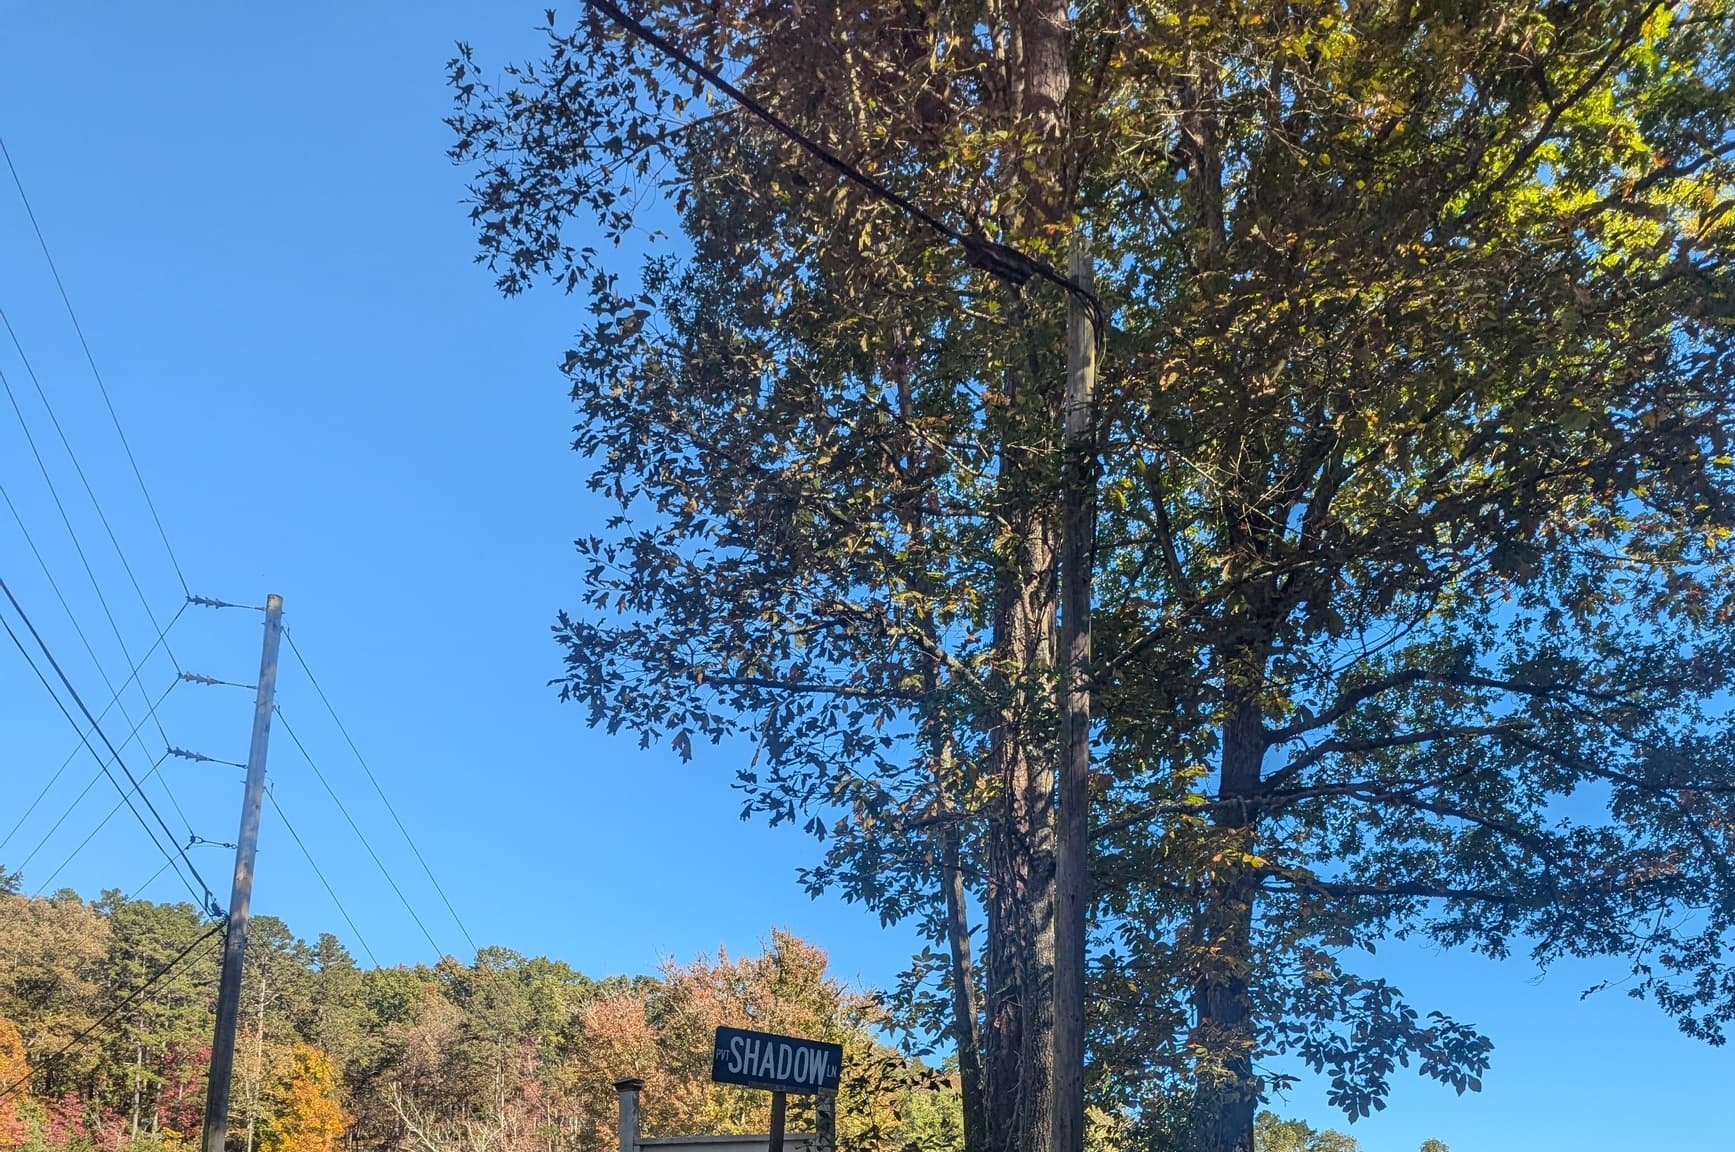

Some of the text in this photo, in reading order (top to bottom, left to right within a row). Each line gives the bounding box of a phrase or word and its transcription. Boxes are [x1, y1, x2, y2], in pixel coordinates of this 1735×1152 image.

[716, 1036, 838, 1085] PVT SHADOW LN
